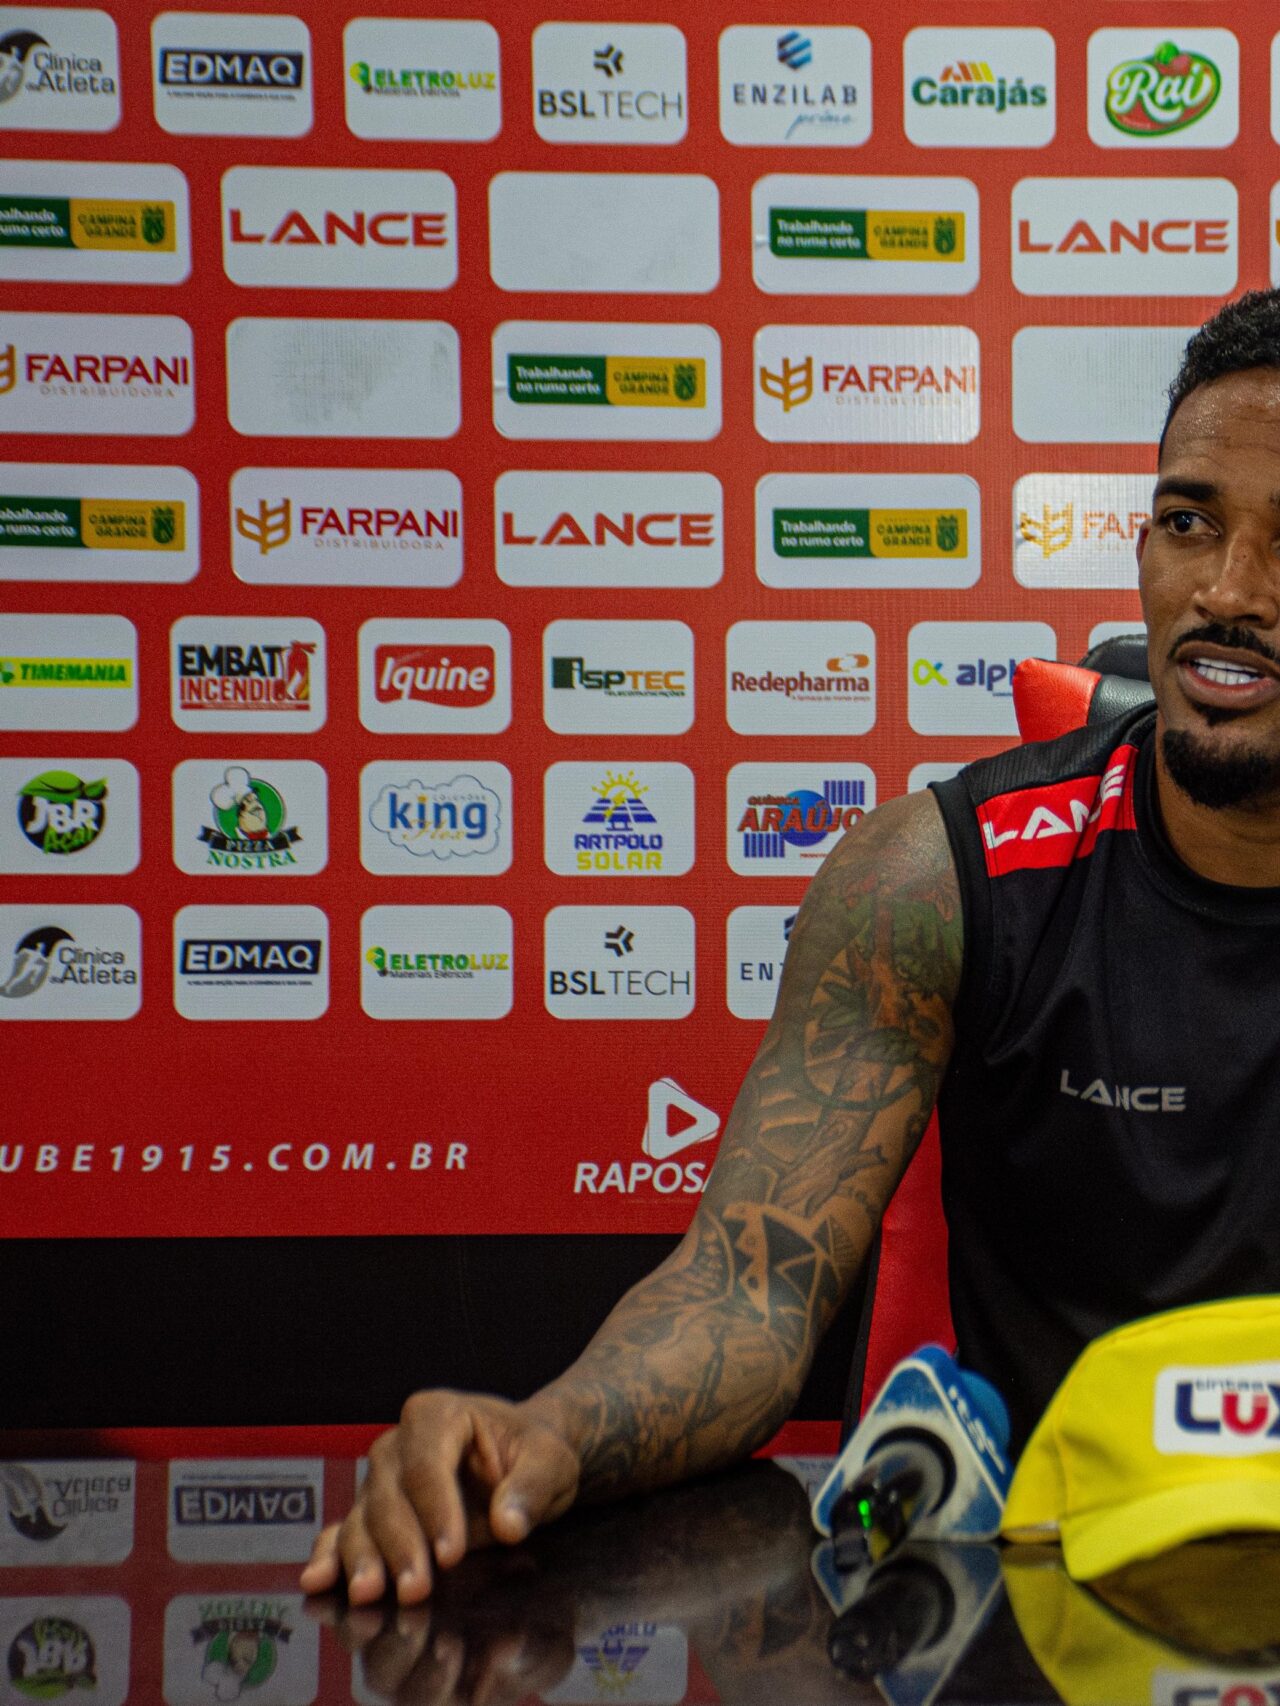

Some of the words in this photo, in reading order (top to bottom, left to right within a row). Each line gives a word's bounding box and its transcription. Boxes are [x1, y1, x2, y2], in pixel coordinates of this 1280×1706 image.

[34, 51, 102, 71] Clínica
[166, 52, 298, 84] EDMAQ
[38, 71, 115, 94] Atleta
[375, 69, 496, 90] ELETROLUZ
[538, 89, 683, 120] BSLTECH
[733, 83, 858, 106] ENZILAB
[912, 75, 1048, 112] Carajás
[1108, 62, 1216, 124] Rai
[229, 209, 447, 247] LANCE
[777, 219, 853, 234] Trabalhando
[1019, 219, 1229, 253] LANCE
[777, 235, 794, 248] no
[798, 237, 826, 248] rumo
[829, 235, 861, 249] certo
[26, 353, 189, 385] FARPANI
[516, 366, 593, 380] Trabalhando
[822, 364, 977, 394] FARPANI
[516, 382, 532, 393] no
[535, 382, 566, 394] rumo
[568, 381, 600, 394] certo
[300, 508, 458, 537] FARPANI
[502, 512, 715, 546] LANCE
[781, 520, 856, 534] Trabalhando
[876, 524, 931, 536] CAMPINA
[313, 537, 445, 550] DISTRIBUIDORA
[781, 536, 796, 547] no
[799, 536, 827, 547] rumo
[830, 535, 864, 547] certo
[883, 535, 931, 546] GRANDE
[21, 663, 127, 683] TIMEMANIA
[381, 657, 489, 699] Iquine
[731, 671, 869, 696] Redepharma
[956, 659, 1016, 692] alp
[27, 796, 98, 834] JBR
[389, 793, 488, 839] king
[737, 798, 863, 833] ARAÚJO
[226, 838, 275, 851] PIZZA
[574, 834, 663, 850] ARTPOLO
[207, 849, 297, 871] NOSTRA
[576, 851, 662, 870] SOLAR
[57, 945, 124, 966] Clínica
[186, 944, 314, 972] EDMAQ
[390, 953, 509, 971] ELETROLUZ
[60, 965, 137, 986] Atleta
[550, 970, 690, 996] BSLTECH
[1060, 1069, 1186, 1111] LANCE
[574, 1162, 706, 1193] RAPOS
